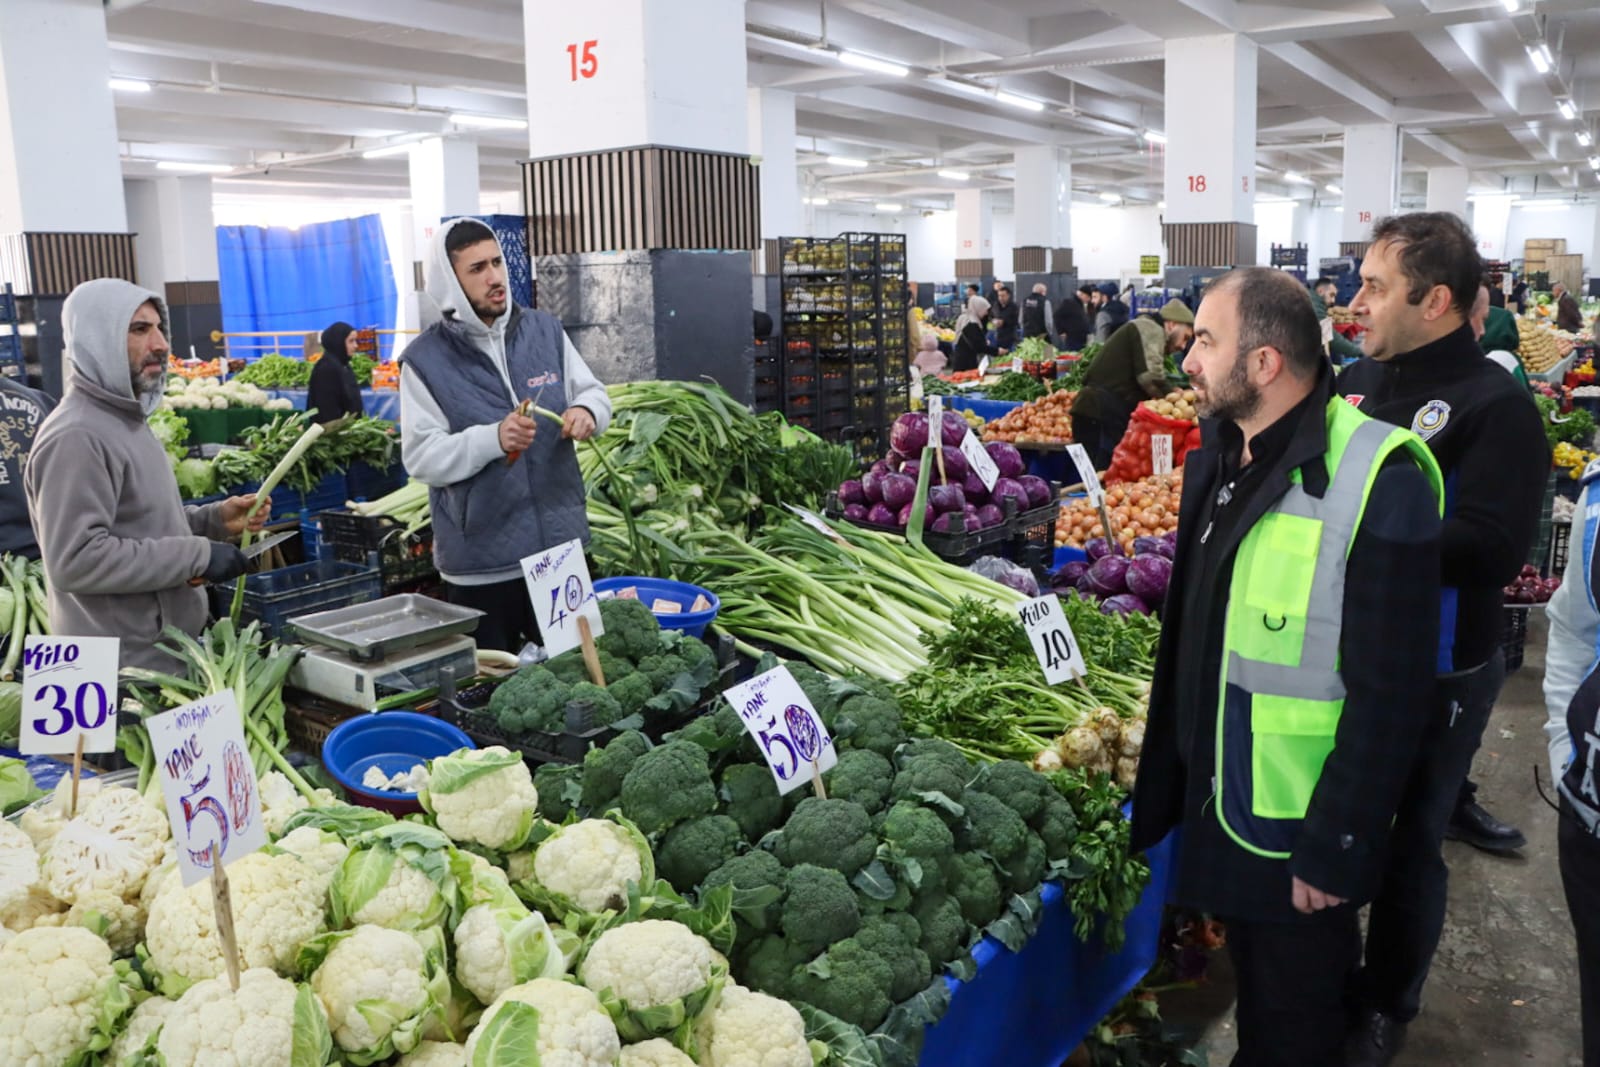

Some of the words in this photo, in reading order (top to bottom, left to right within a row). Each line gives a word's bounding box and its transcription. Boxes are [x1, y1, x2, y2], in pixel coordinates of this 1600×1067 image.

[566, 40, 598, 82] 15
[1187, 174, 1206, 193] 18
[1359, 211, 1371, 223] 18
[529, 553, 554, 582] TANE
[548, 574, 584, 630] 40
[1041, 628, 1071, 670] 40
[32, 681, 108, 736] 30
[742, 690, 769, 720] TANE
[163, 733, 204, 781] TANE
[757, 704, 821, 781] 50
